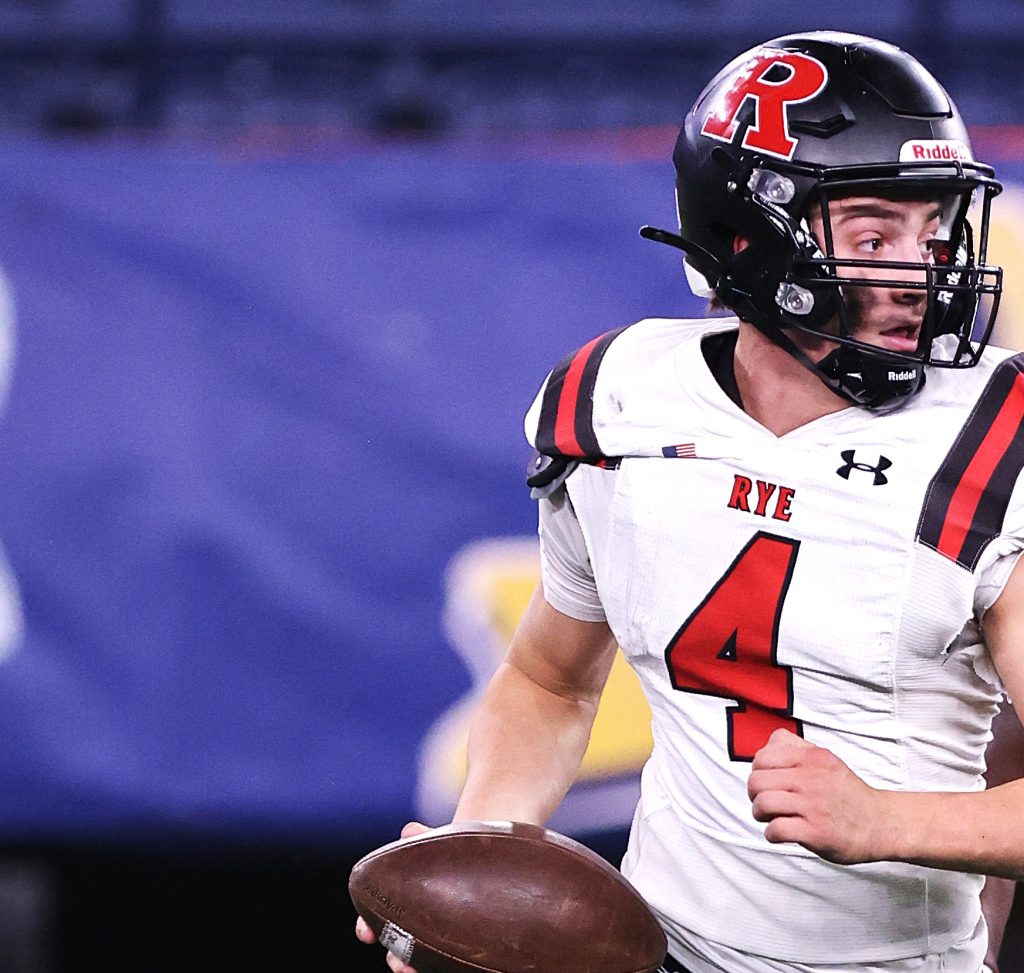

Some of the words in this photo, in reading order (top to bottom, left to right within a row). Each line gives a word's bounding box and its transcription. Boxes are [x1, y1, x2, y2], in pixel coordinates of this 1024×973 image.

[700, 48, 830, 162] R
[887, 368, 918, 382] Riddell
[727, 473, 796, 522] RYE
[664, 530, 805, 763] 4
